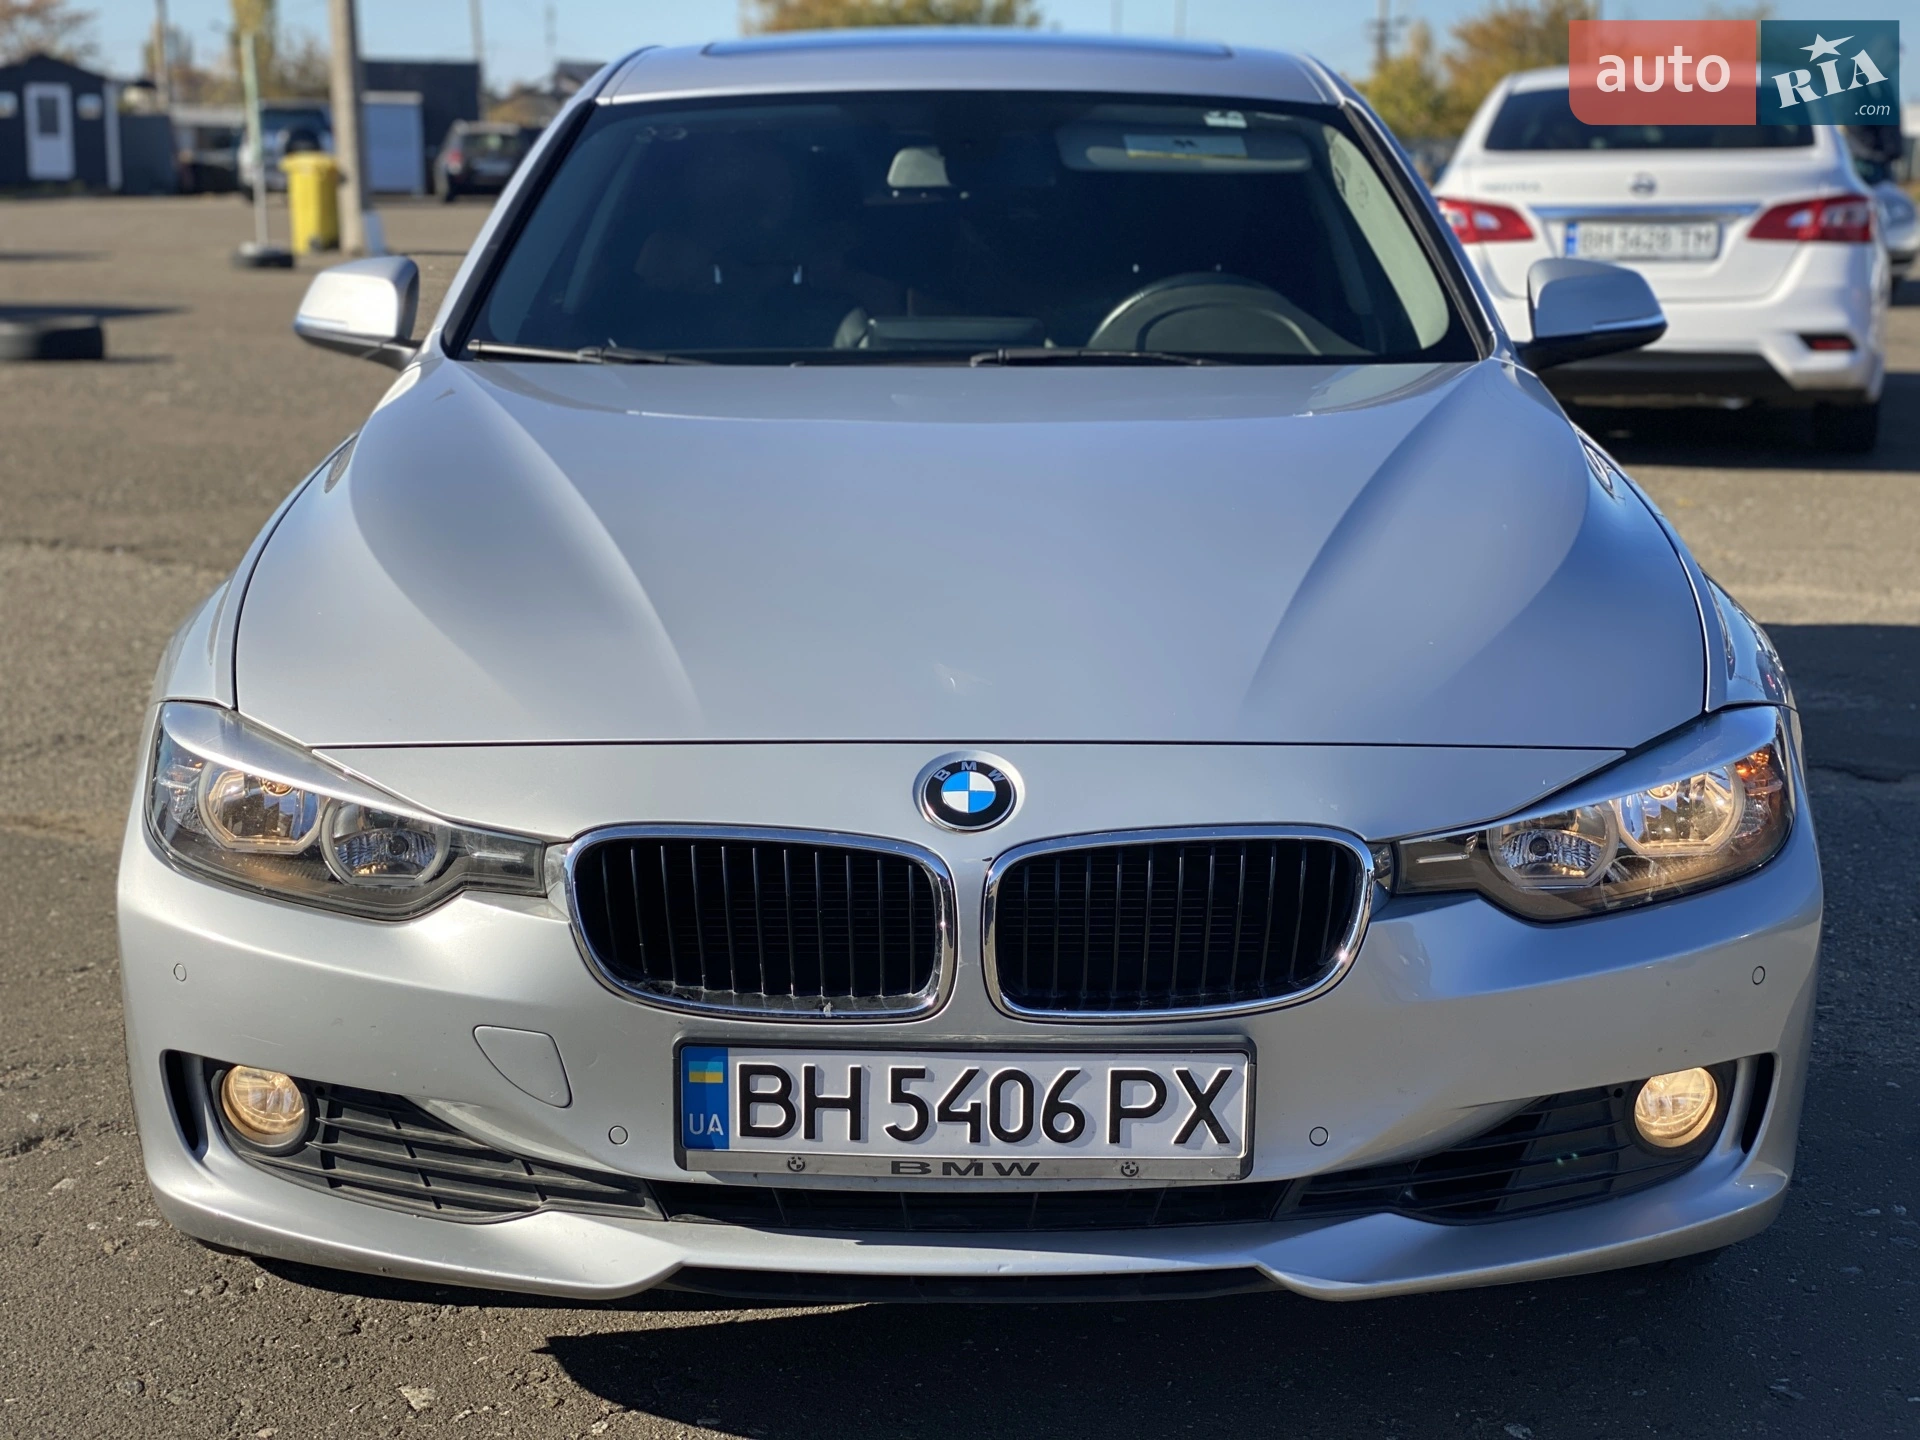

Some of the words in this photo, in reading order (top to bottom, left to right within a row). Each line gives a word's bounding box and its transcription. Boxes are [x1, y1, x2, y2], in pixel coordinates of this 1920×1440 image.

[933, 760, 1007, 783] BMW
[737, 1062, 863, 1142] BH
[884, 1065, 1087, 1145] 5406
[1107, 1067, 1234, 1145] PX
[688, 1112, 725, 1137] UA
[890, 1160, 1041, 1177] BMW
